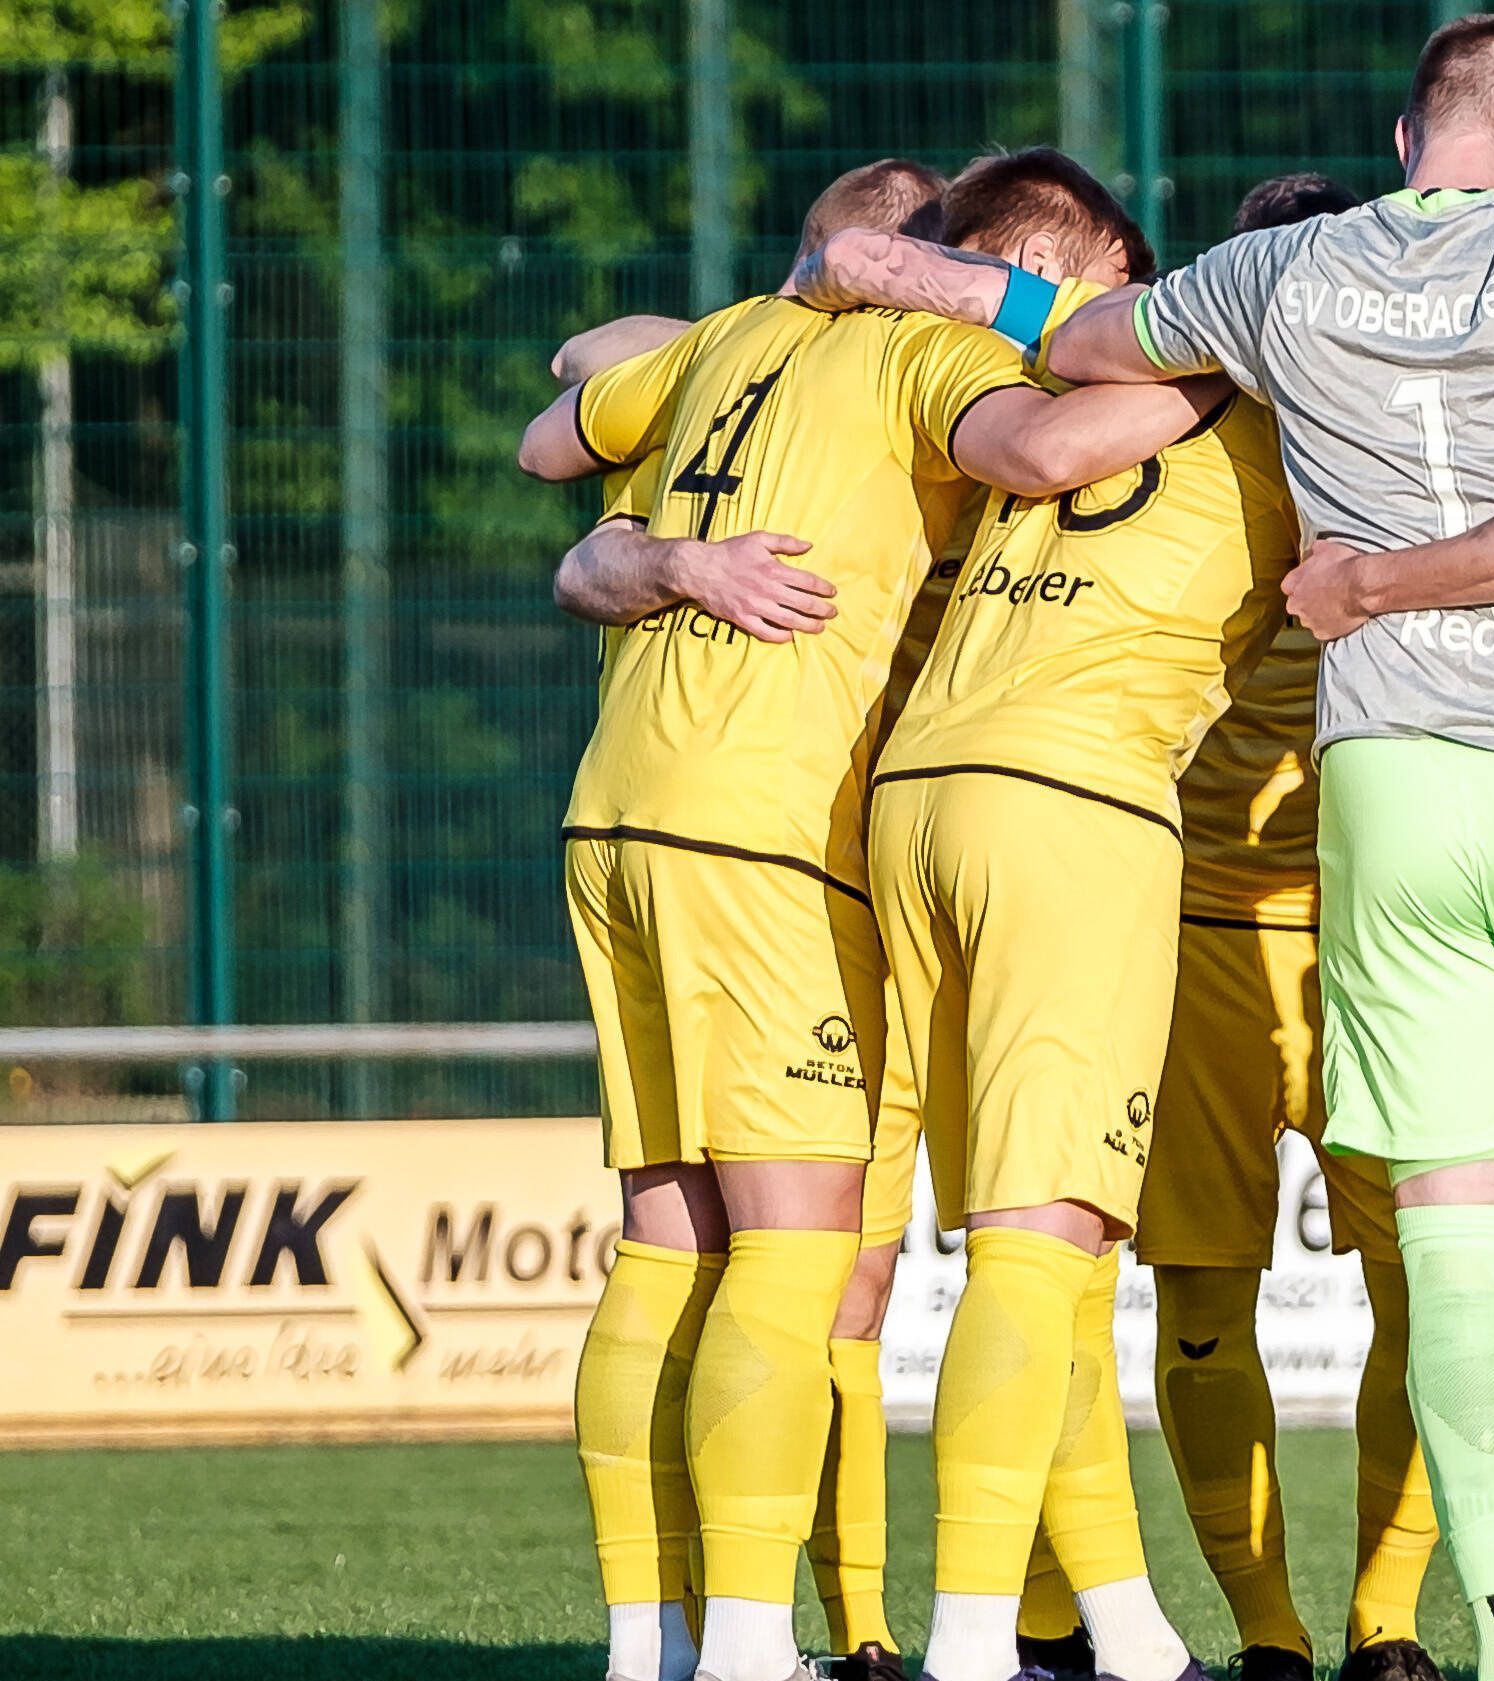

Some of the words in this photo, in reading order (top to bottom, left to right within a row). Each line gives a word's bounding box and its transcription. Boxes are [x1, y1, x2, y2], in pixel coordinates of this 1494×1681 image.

[1285, 281, 1330, 326] SV
[669, 345, 795, 542] 4
[1383, 370, 1472, 540] 1
[0, 1180, 362, 1290] FINK
